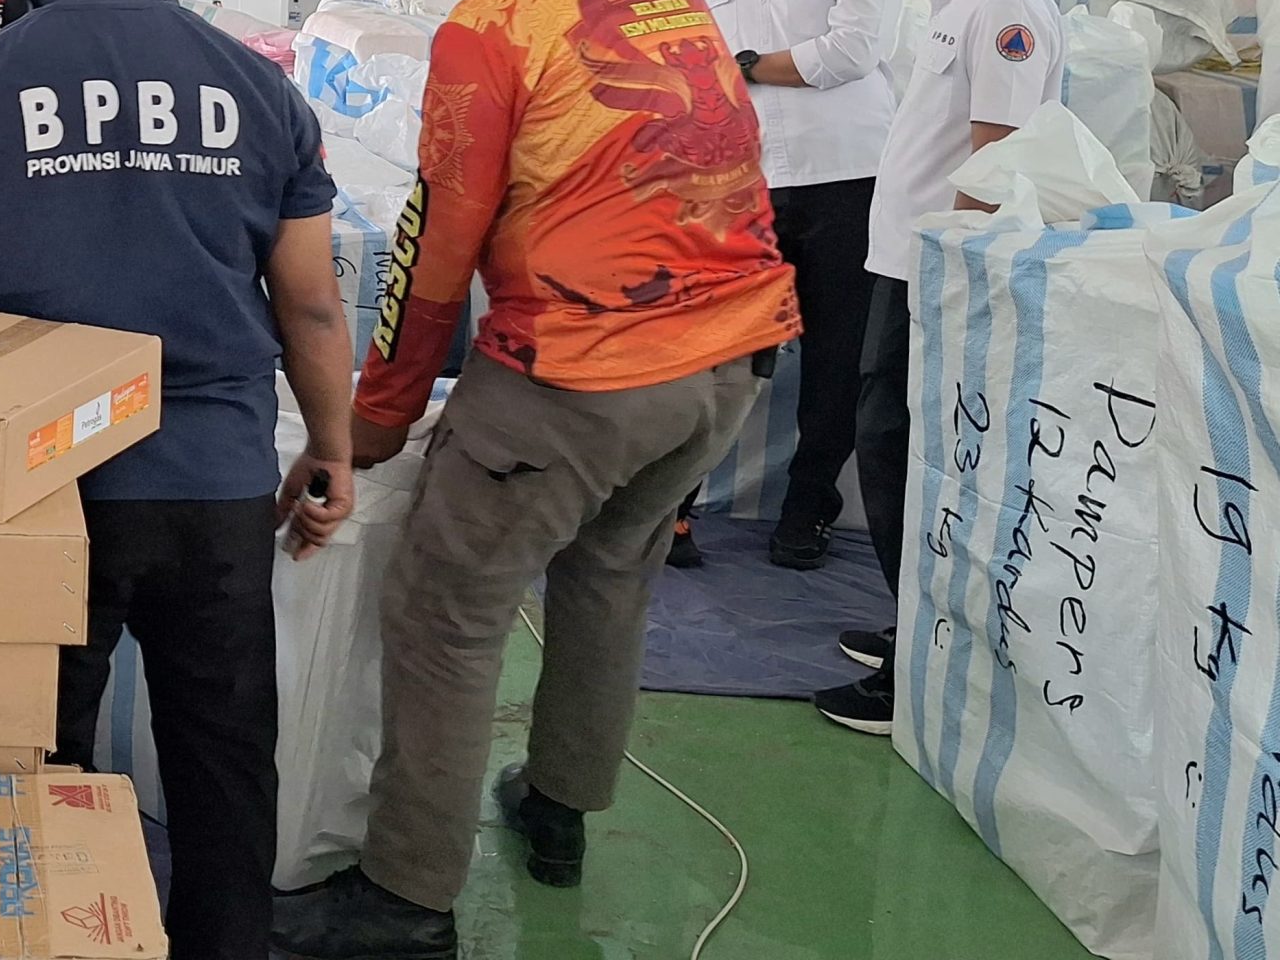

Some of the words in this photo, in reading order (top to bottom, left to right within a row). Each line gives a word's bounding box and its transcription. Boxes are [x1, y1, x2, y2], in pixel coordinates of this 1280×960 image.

[19, 79, 240, 152] BPBD
[26, 150, 120, 178] PROVINSI
[124, 149, 173, 171] JAWA
[178, 153, 241, 177] TIMUR
[953, 382, 990, 473] 23
[1028, 398, 1071, 467] 12
